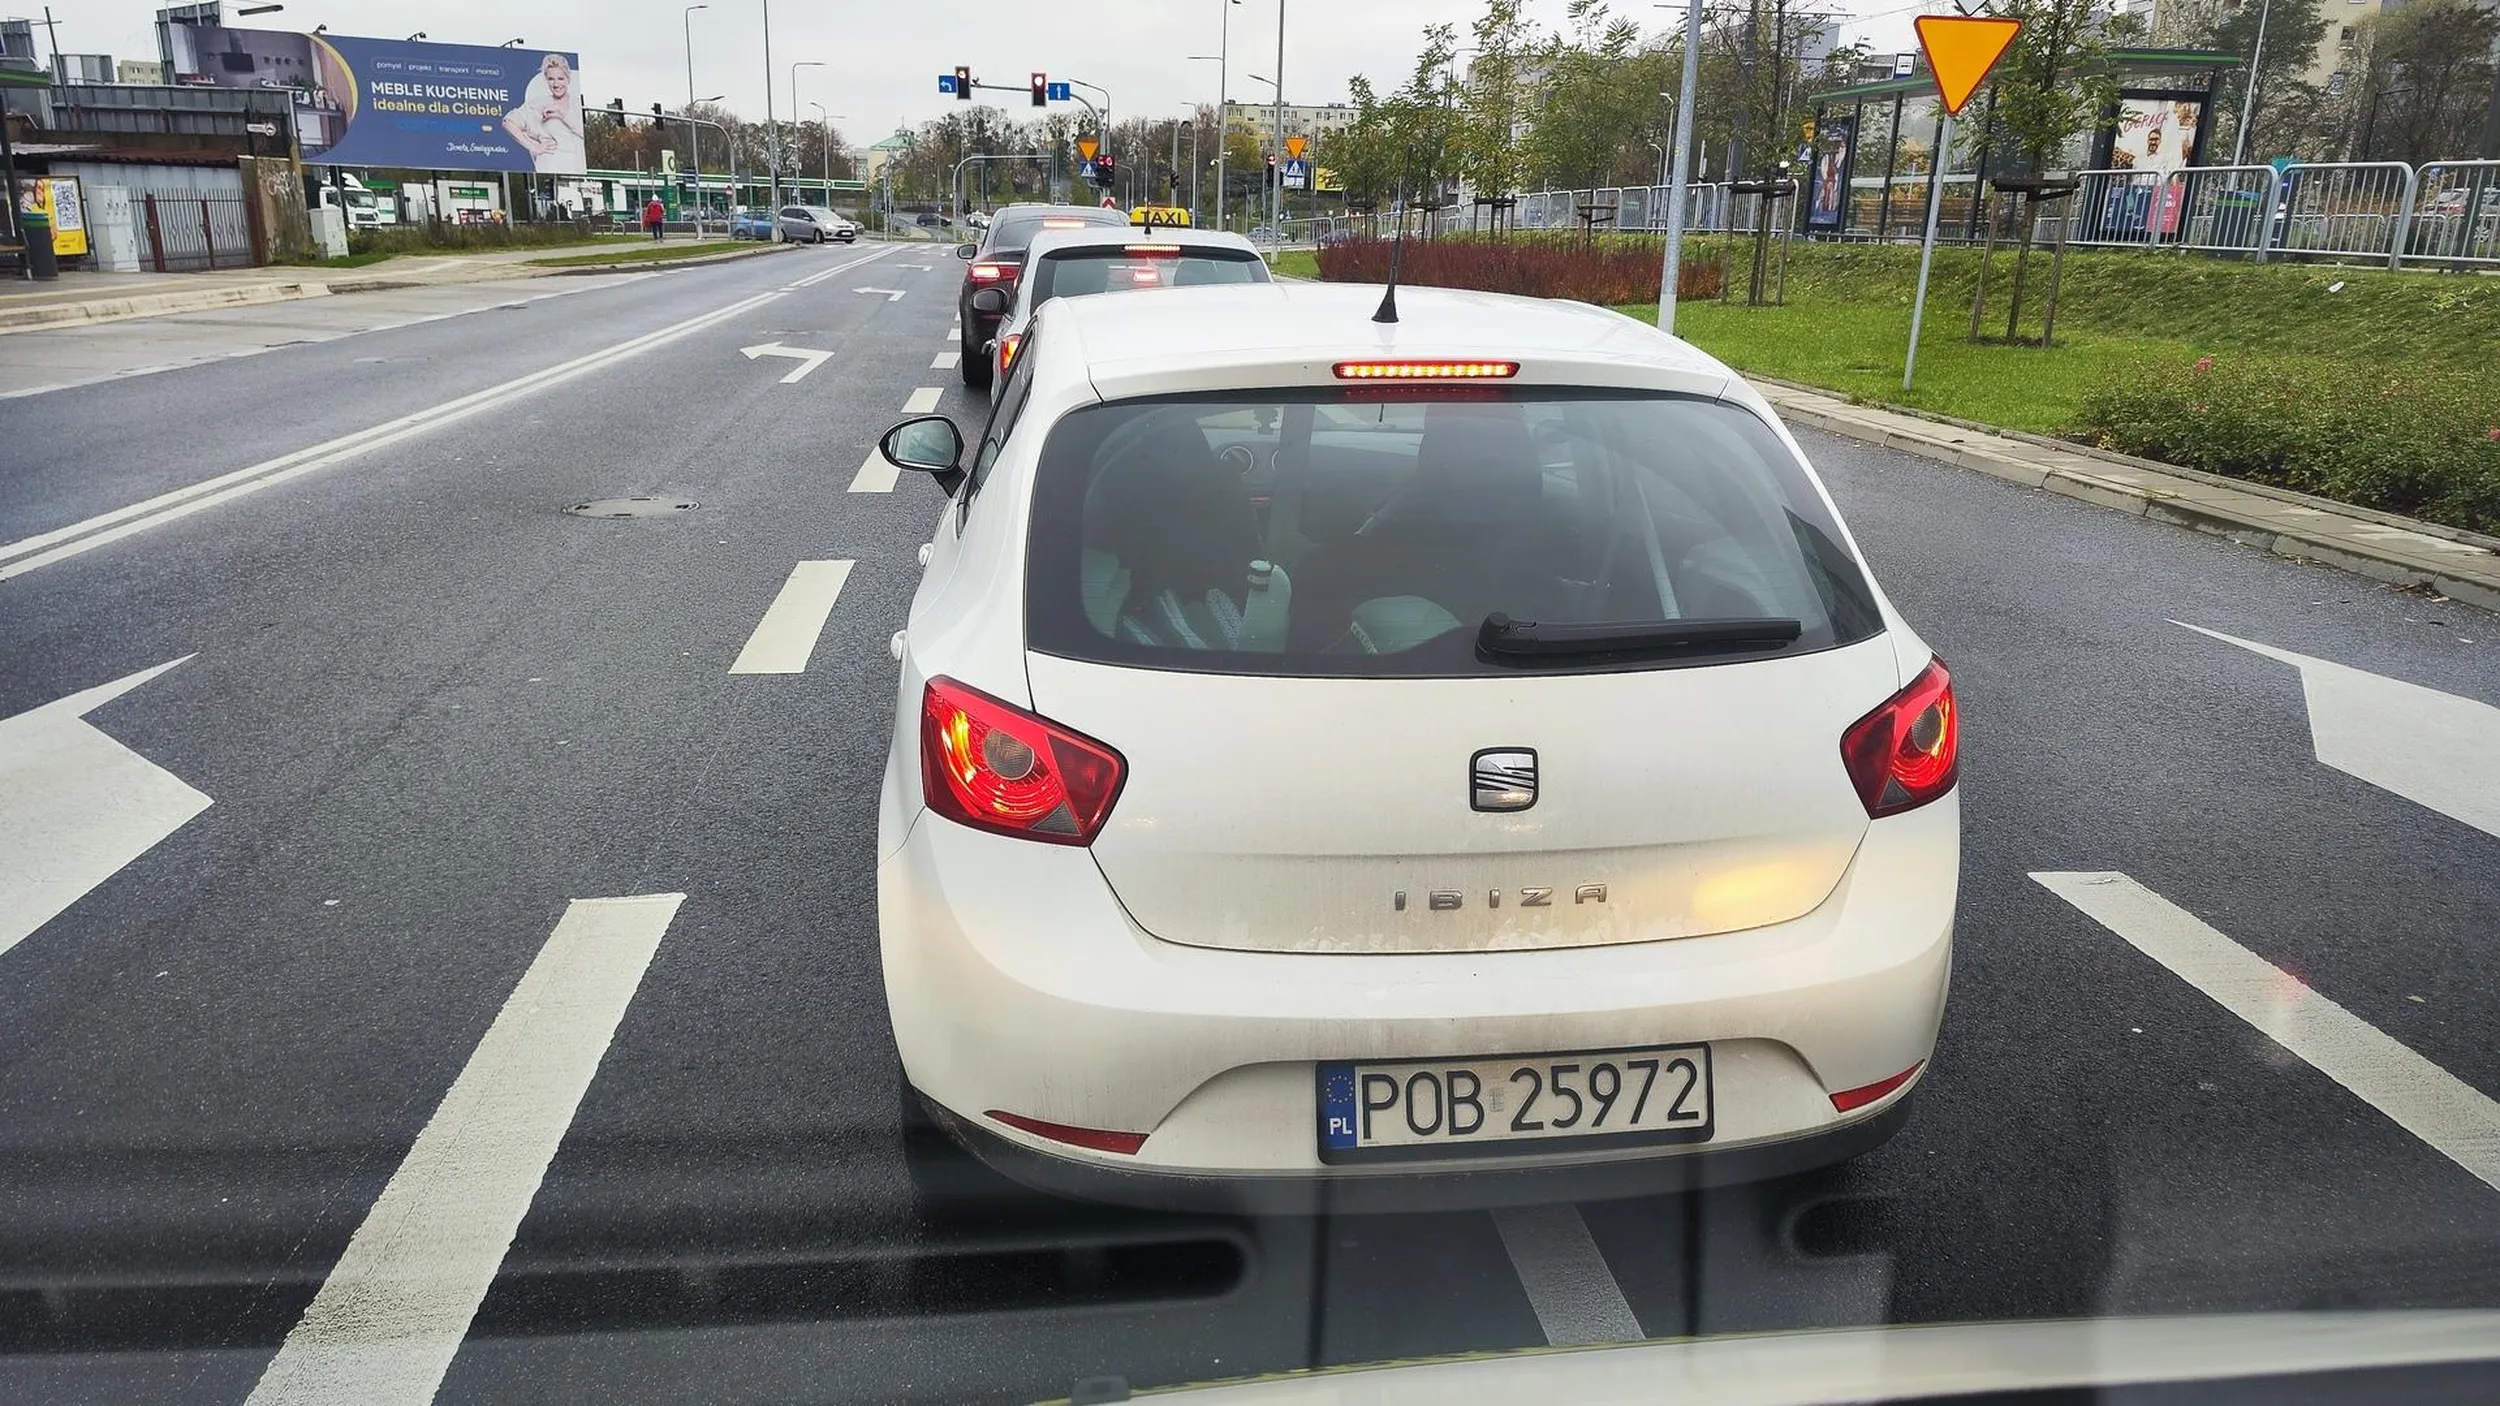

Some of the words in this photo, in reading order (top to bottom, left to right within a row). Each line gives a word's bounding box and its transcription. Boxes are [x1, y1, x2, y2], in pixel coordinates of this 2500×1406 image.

[439, 65, 469, 75] transport
[371, 81, 423, 97] MEBLE
[425, 84, 509, 102] KUCHENNE
[373, 97, 426, 113] idealne
[428, 101, 450, 115] dla
[452, 102, 502, 116] Ciebie!
[1141, 210, 1181, 225] TAXI
[1394, 883, 1607, 911] IBIZA
[1329, 1116, 1353, 1136] PL
[1360, 1070, 1486, 1140] POB
[1508, 1057, 1700, 1133] 25972
